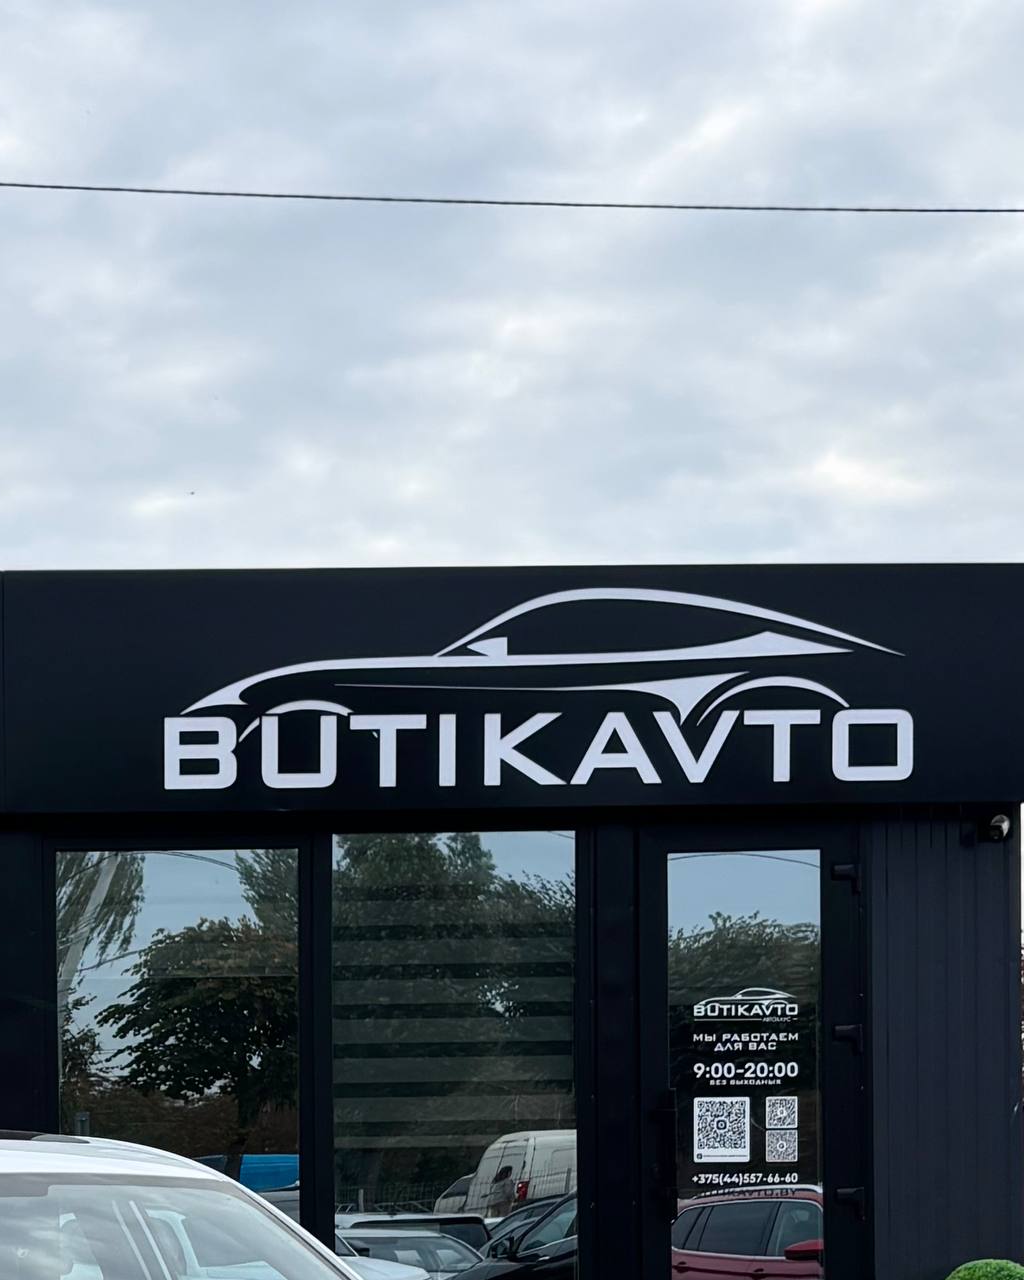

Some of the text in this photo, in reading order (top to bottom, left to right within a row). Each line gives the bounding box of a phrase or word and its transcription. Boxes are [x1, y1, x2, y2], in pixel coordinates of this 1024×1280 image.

[163, 708, 915, 790] BUTIKAVTO
[693, 1003, 798, 1017] BUTIKAVTO
[693, 1032, 799, 1042] МЫ РАБОТАЕМ
[714, 1041, 777, 1051] ДЛЯ ВАС
[693, 1062, 799, 1078] 9:00-20:00
[691, 1173, 799, 1186] +375(44)557-66-60
